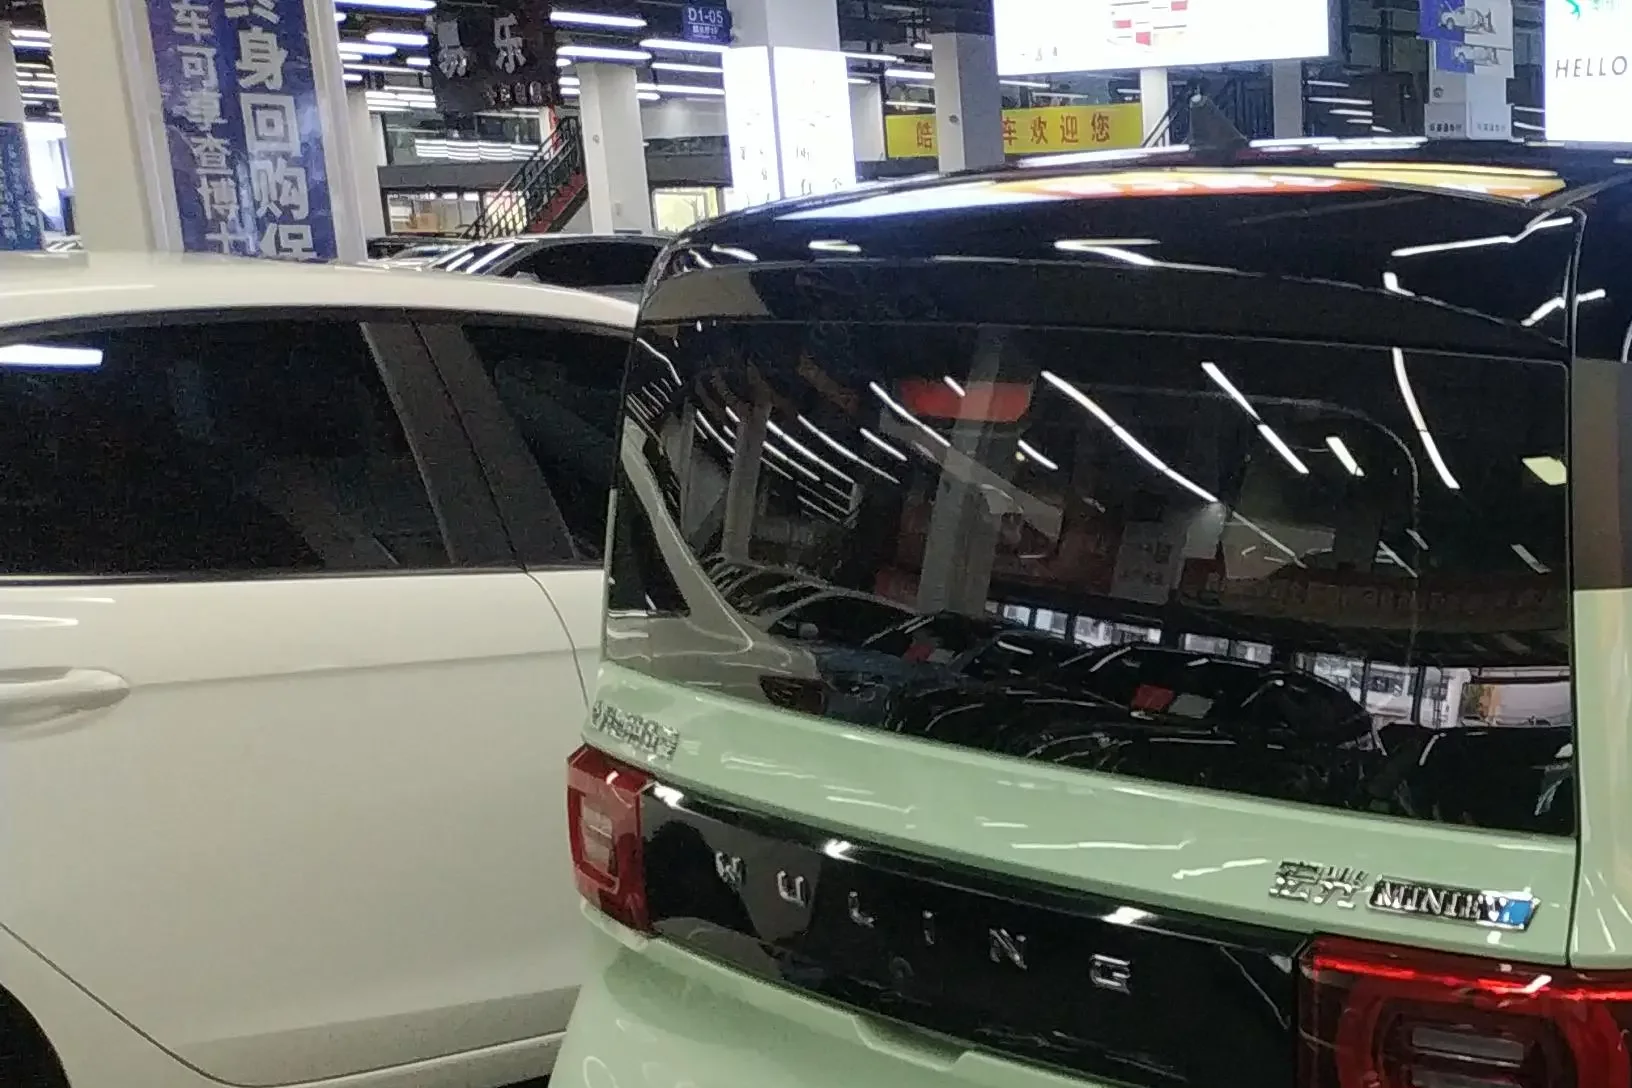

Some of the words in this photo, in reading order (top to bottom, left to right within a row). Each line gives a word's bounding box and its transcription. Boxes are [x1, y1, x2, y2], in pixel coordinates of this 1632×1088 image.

[687, 7, 724, 24] D1-05
[1555, 55, 1628, 79] HELLO
[714, 850, 1132, 995] WULING
